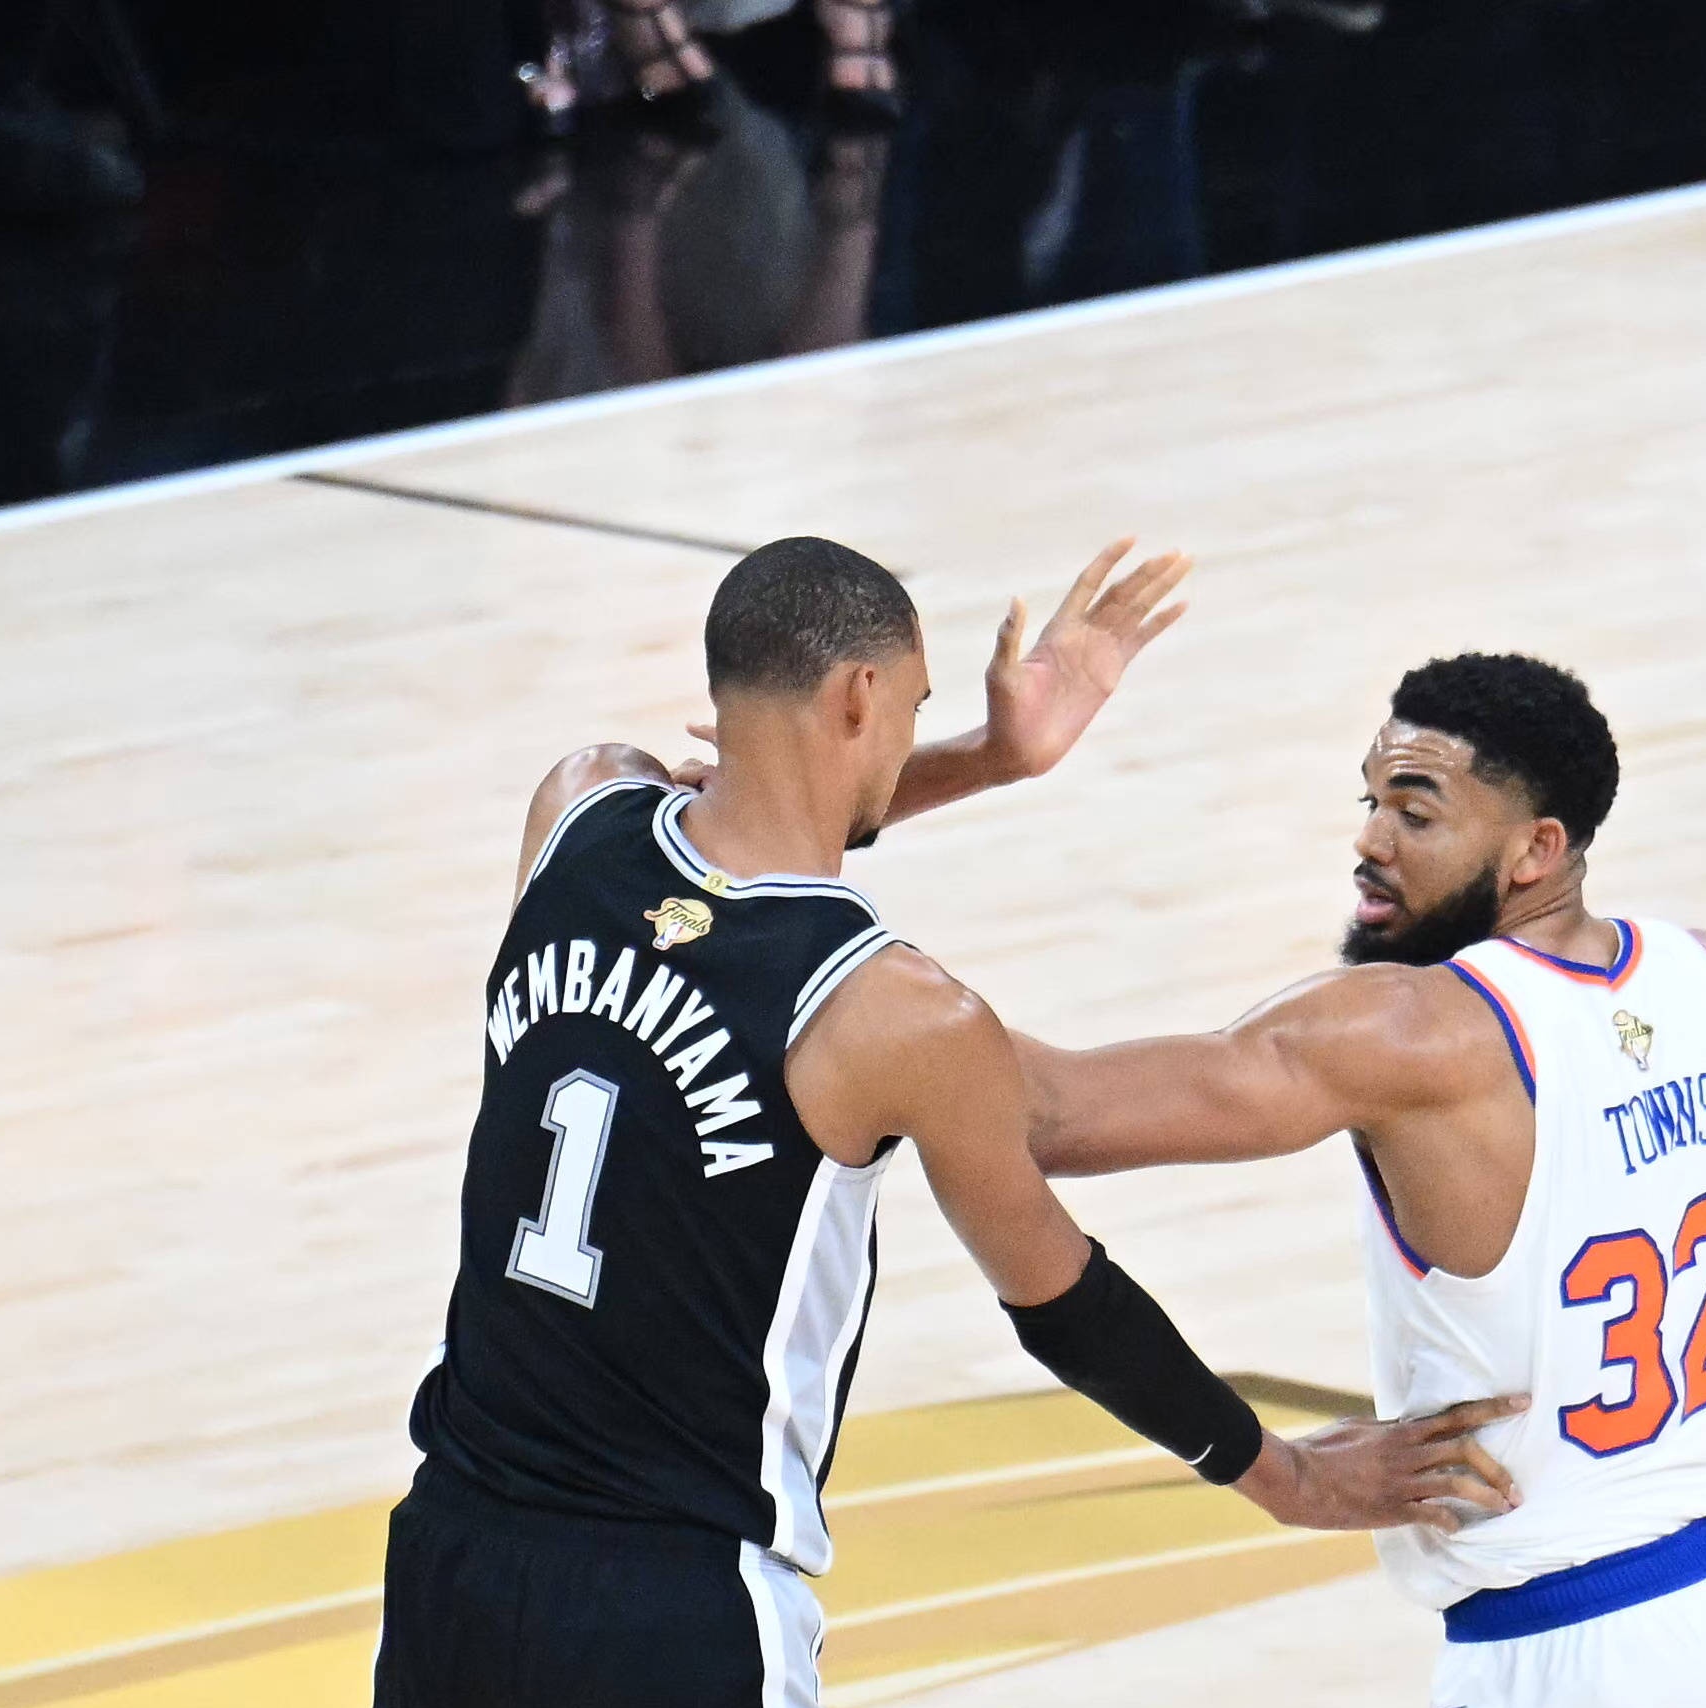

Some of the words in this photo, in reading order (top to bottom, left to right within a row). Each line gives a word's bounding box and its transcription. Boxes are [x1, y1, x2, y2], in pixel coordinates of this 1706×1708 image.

[647, 900, 709, 934] Finals
[488, 939, 774, 1178] WEMBANYAMA
[505, 1068, 620, 1309] 1
